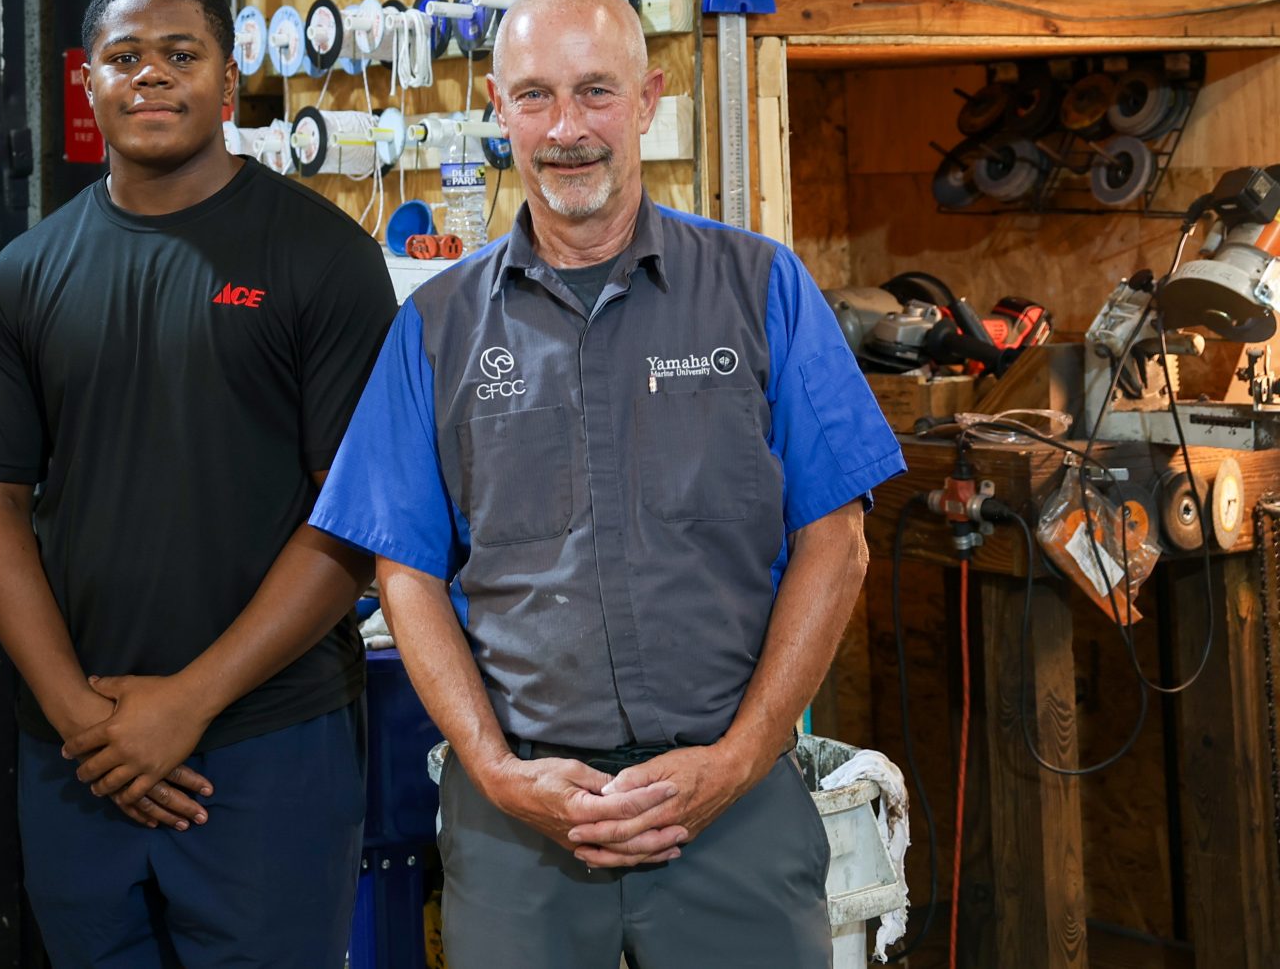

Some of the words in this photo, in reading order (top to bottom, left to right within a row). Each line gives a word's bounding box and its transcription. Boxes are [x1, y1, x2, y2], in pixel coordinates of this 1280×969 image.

[452, 176, 477, 185] PARK
[212, 282, 266, 308] ACE
[646, 354, 710, 371] Yamaha
[651, 370, 674, 378] Marine
[676, 367, 710, 377] University
[476, 379, 526, 400] CFCC
